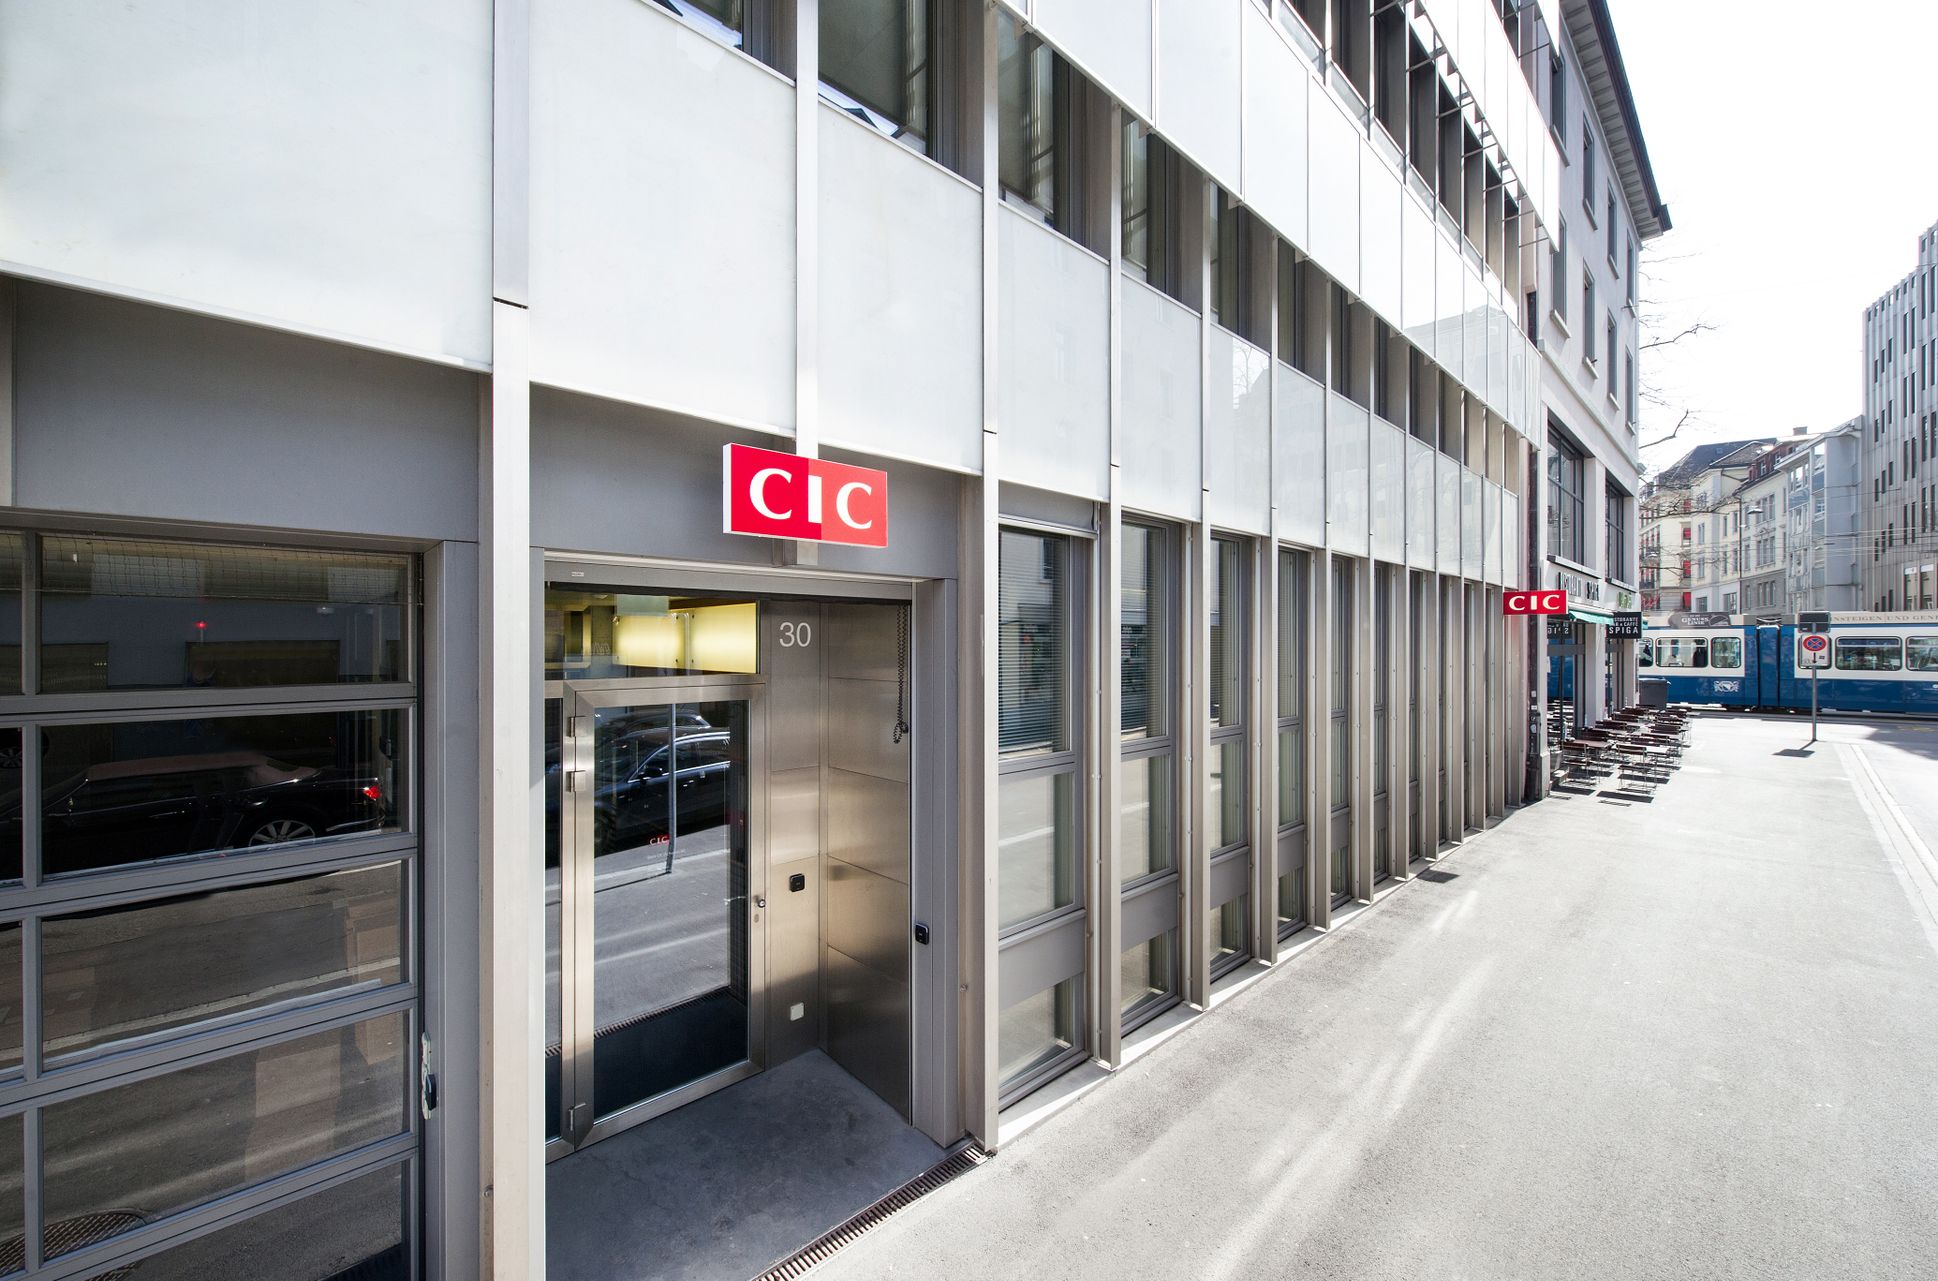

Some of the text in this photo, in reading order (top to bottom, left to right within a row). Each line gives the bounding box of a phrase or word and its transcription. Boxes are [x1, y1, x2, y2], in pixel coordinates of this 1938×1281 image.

[750, 468, 872, 530] CIC
[1508, 594, 1560, 611] CIC
[779, 621, 812, 647] 30
[1608, 626, 1639, 634] SPIGA
[649, 836, 669, 846] CIC
